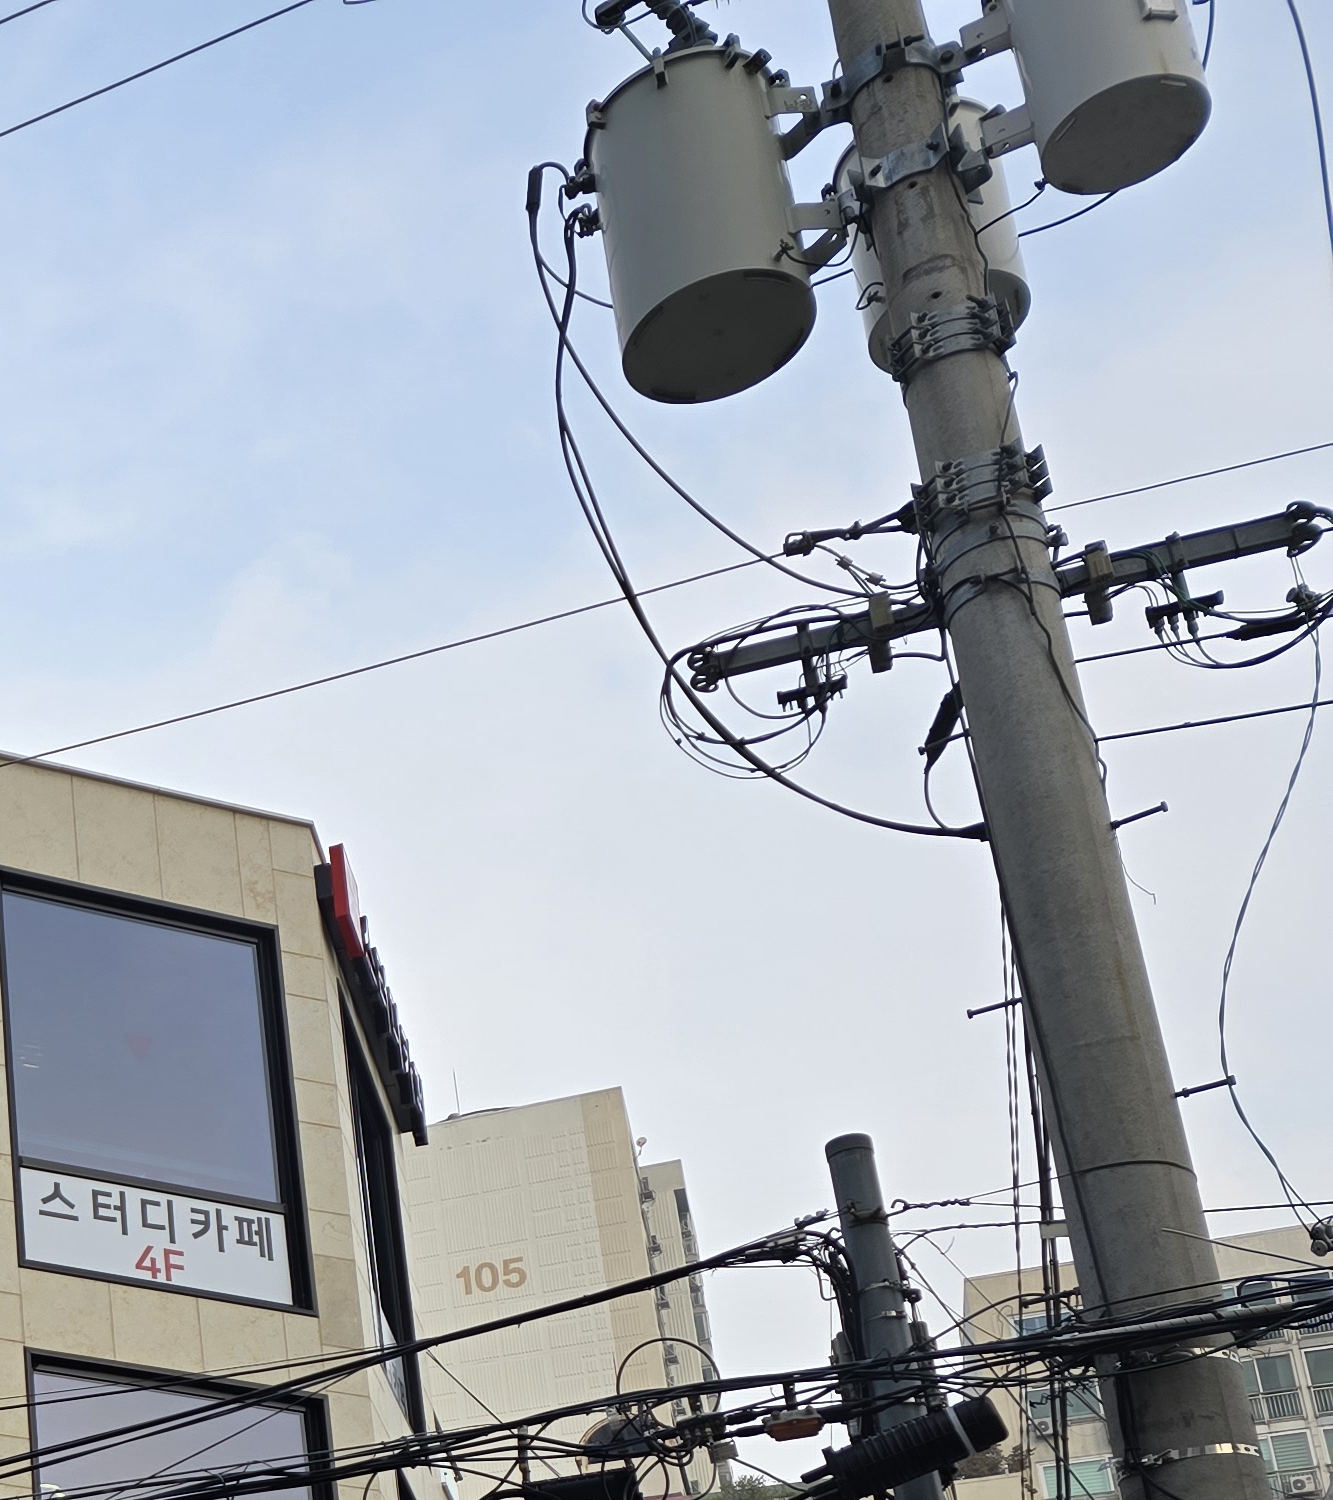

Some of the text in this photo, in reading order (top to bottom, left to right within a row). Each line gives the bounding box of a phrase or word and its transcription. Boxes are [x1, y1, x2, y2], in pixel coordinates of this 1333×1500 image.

[38, 1182, 274, 1261] 스터디카페
[134, 1245, 186, 1282] 4F
[455, 1256, 528, 1296] 105
